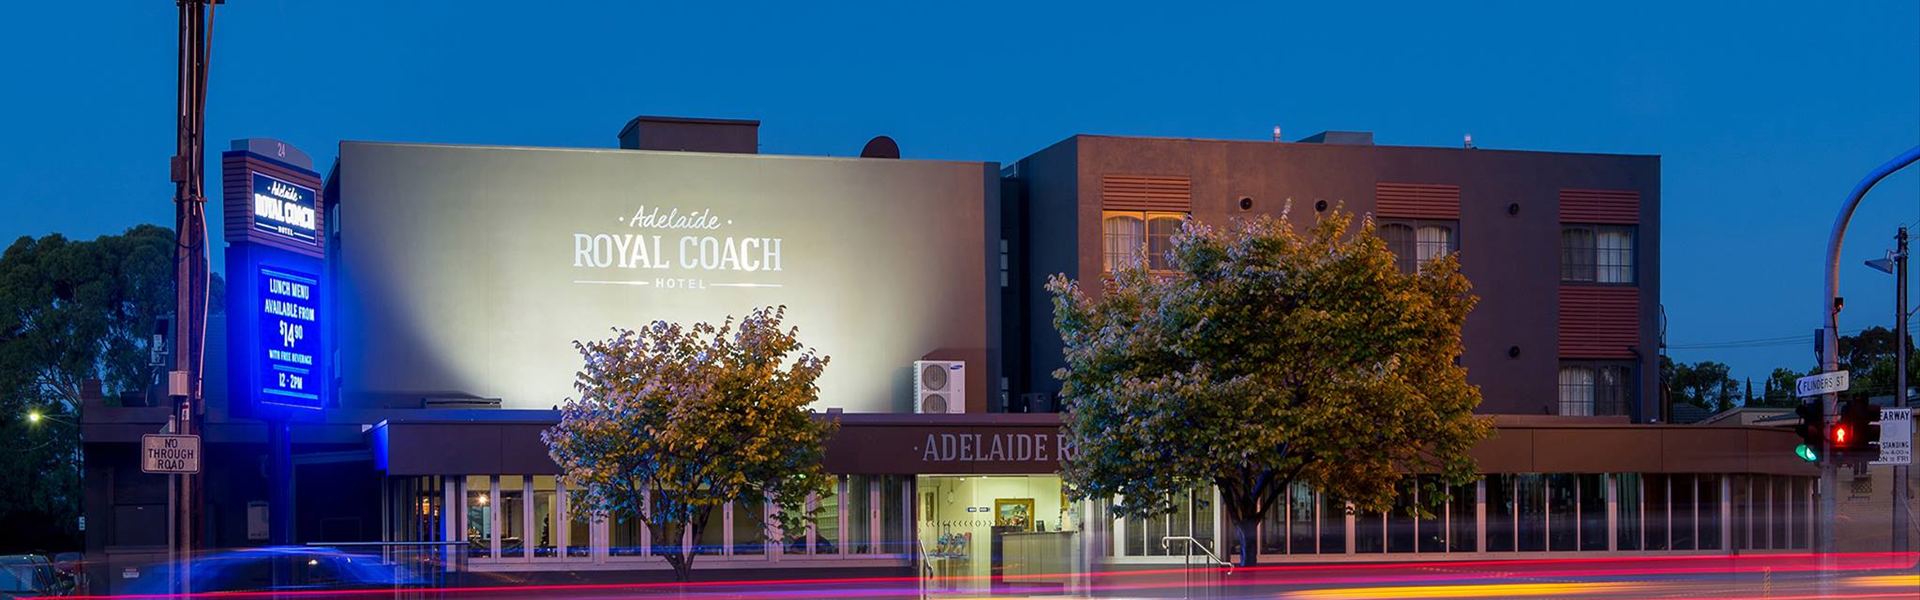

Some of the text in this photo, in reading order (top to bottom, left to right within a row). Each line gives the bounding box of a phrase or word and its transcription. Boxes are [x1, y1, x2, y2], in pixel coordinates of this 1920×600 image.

[277, 142, 285, 157] 24
[254, 193, 315, 230] ROYAL COACH
[629, 205, 721, 230] Adelaide
[573, 233, 783, 272] ROYAL COACH
[269, 278, 309, 300] LUNCH MENU
[655, 278, 706, 289] HOTEL
[264, 298, 315, 321] AVAILABLE FROM
[269, 349, 280, 360] WITH
[280, 351, 291, 362] FREE
[290, 374, 303, 390] 2PM
[1803, 376, 1844, 391] FLINDERS ST
[164, 438, 178, 448] NO
[922, 434, 1048, 462] ADELAIDE
[148, 448, 194, 459] THROUGH
[157, 459, 185, 470] ROAD
